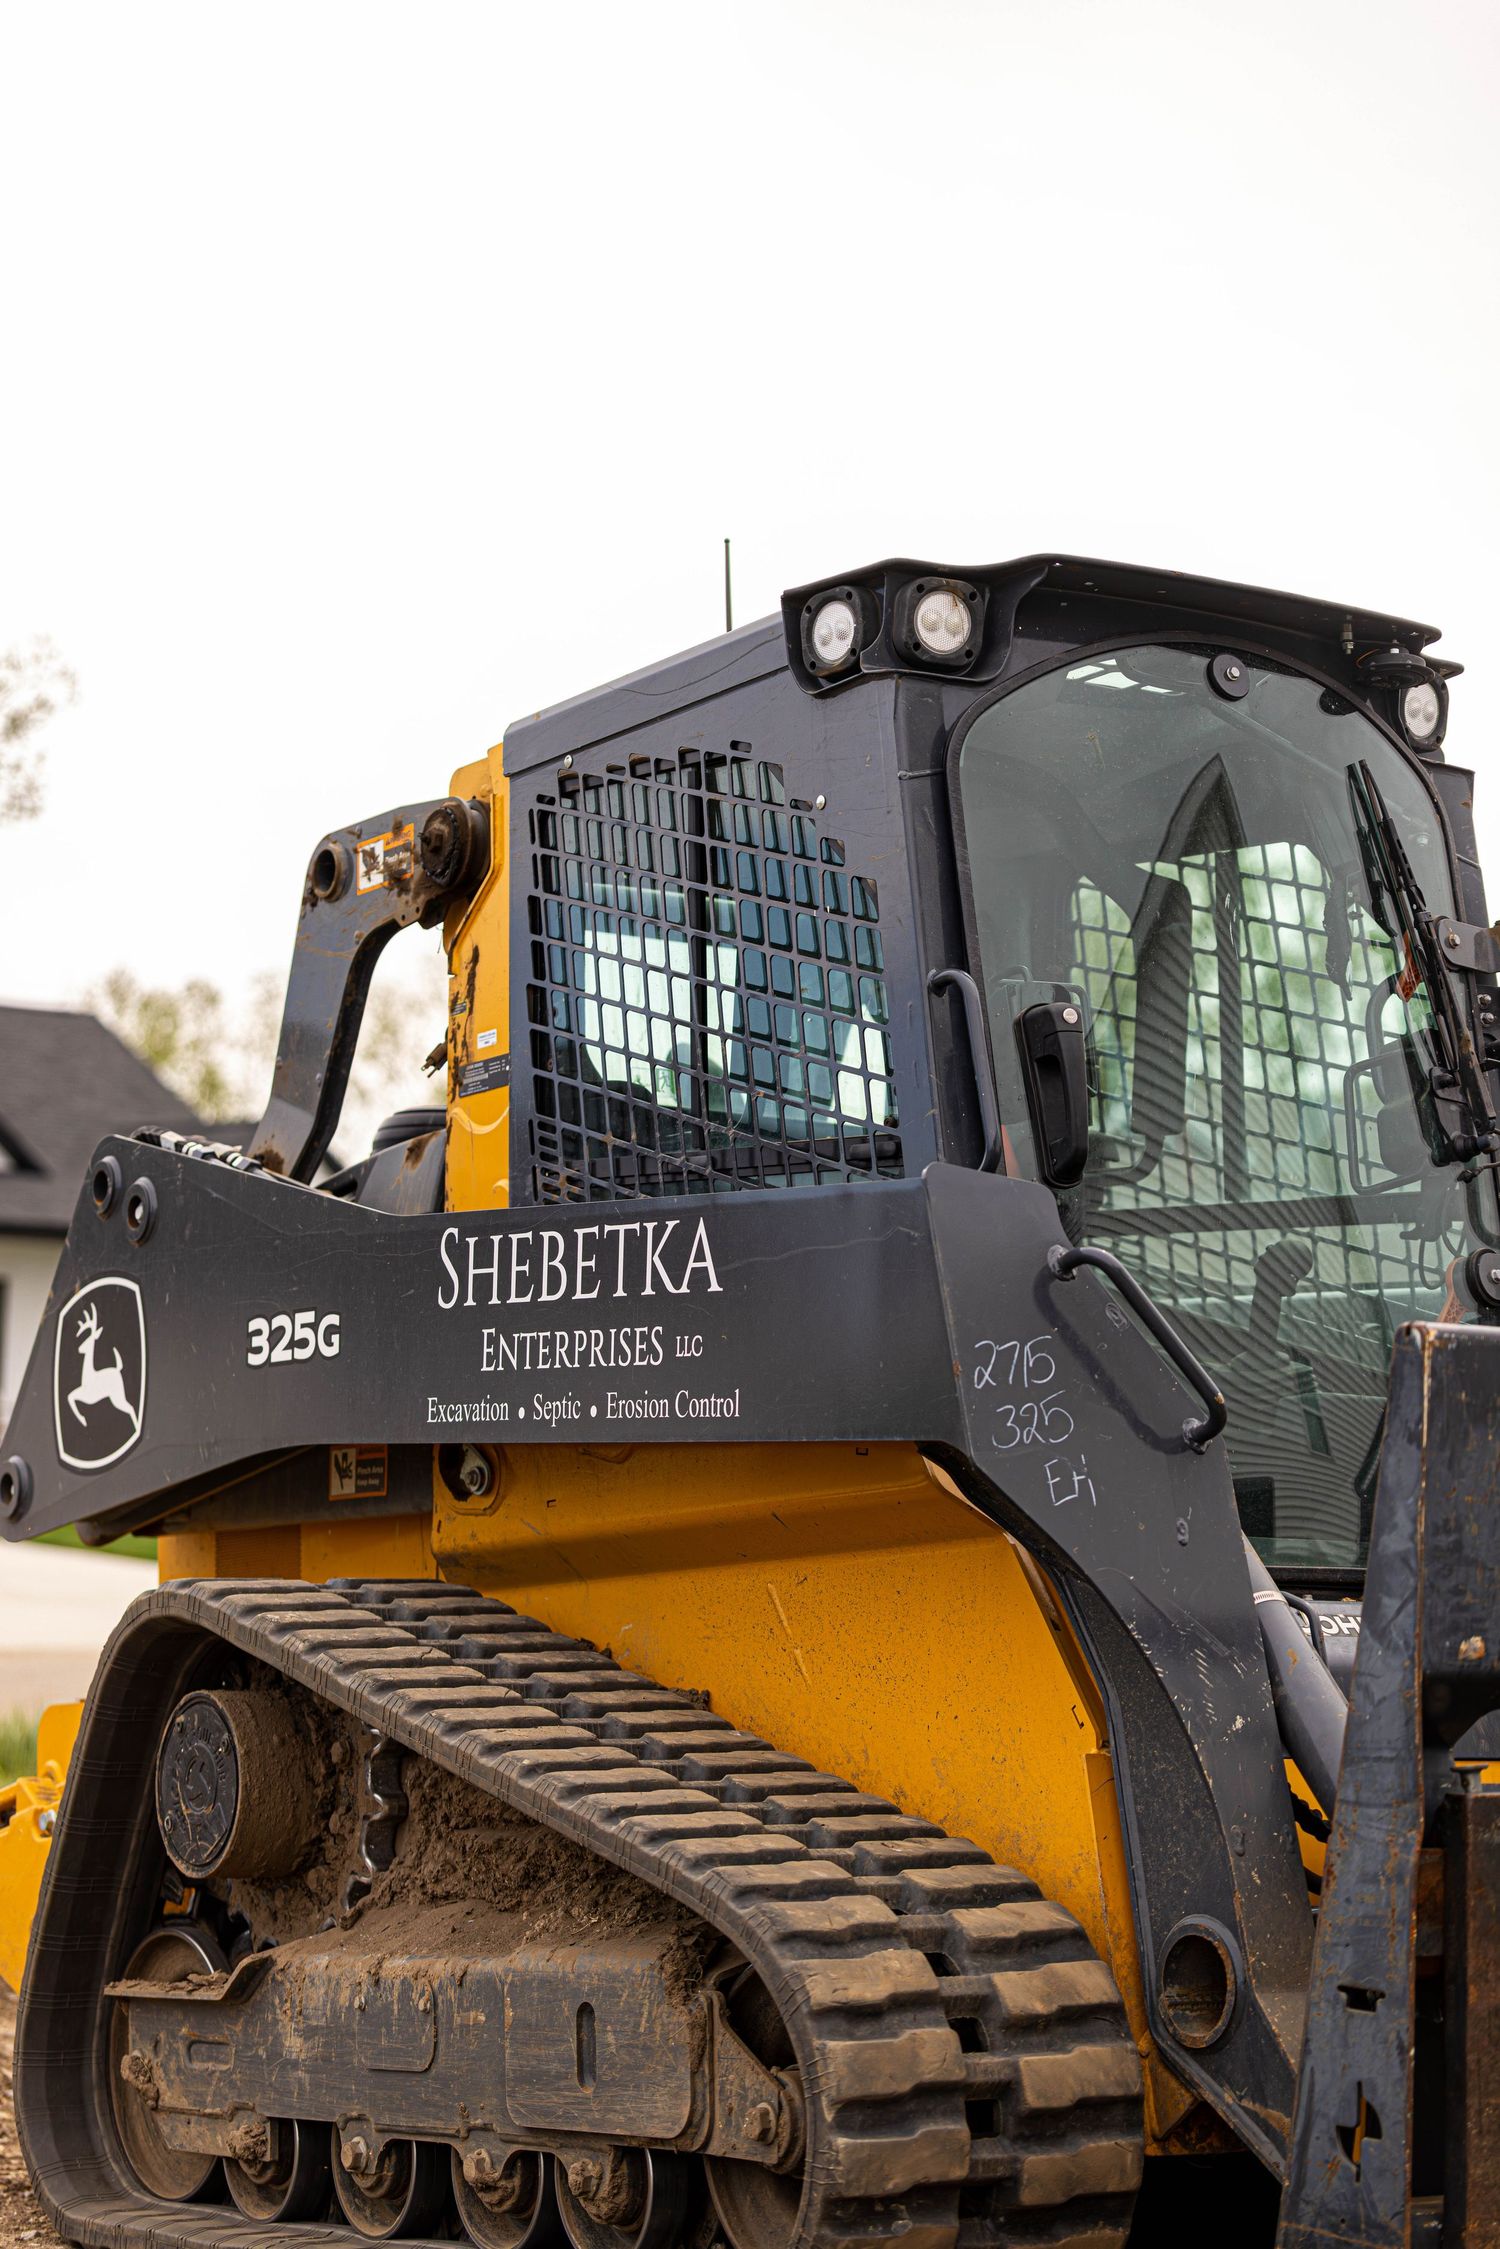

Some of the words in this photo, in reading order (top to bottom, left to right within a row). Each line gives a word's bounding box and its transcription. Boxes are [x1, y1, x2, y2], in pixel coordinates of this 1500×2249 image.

[437, 1216, 724, 1310] SHEBETKA
[247, 1311, 340, 1366] 325G
[480, 1327, 664, 1372] ENTERPRISES
[675, 1335, 703, 1358] LLC
[426, 1396, 510, 1423] Excavation
[532, 1393, 581, 1428] Septic
[605, 1391, 670, 1419] Erosion
[674, 1388, 740, 1419] Control
[991, 1389, 1075, 1449] 325
